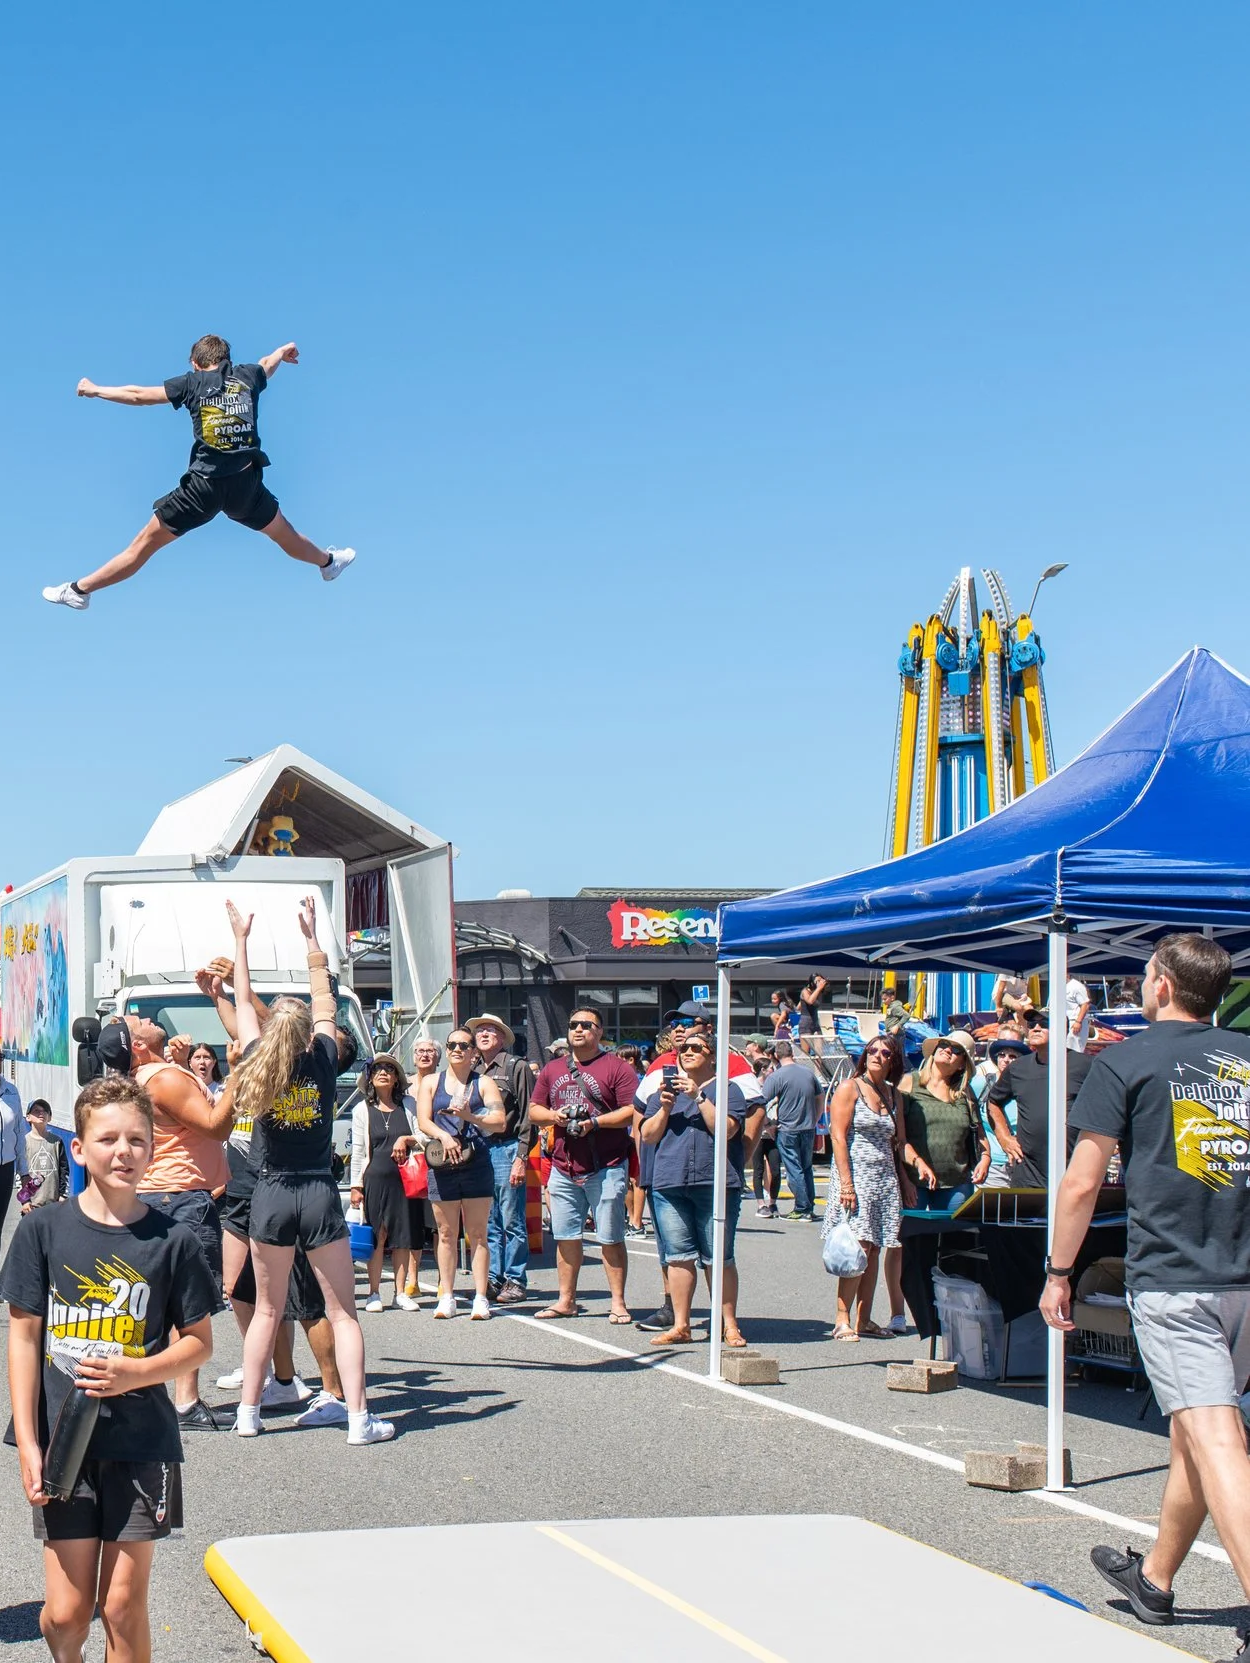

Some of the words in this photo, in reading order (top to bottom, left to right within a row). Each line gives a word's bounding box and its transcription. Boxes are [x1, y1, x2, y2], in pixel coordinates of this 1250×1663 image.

[214, 423, 252, 436] PYROAR
[621, 911, 720, 940] Resen
[559, 1090, 578, 1099] MAKE
[1171, 1082, 1242, 1101] Delphox
[1200, 1140, 1250, 1155] PYRO
[1207, 1162, 1225, 1171] EST.
[1227, 1162, 1250, 1171] 2014
[108, 1278, 151, 1322] 20
[48, 1294, 135, 1344] Ignite
[155, 1461, 170, 1523] Champ
